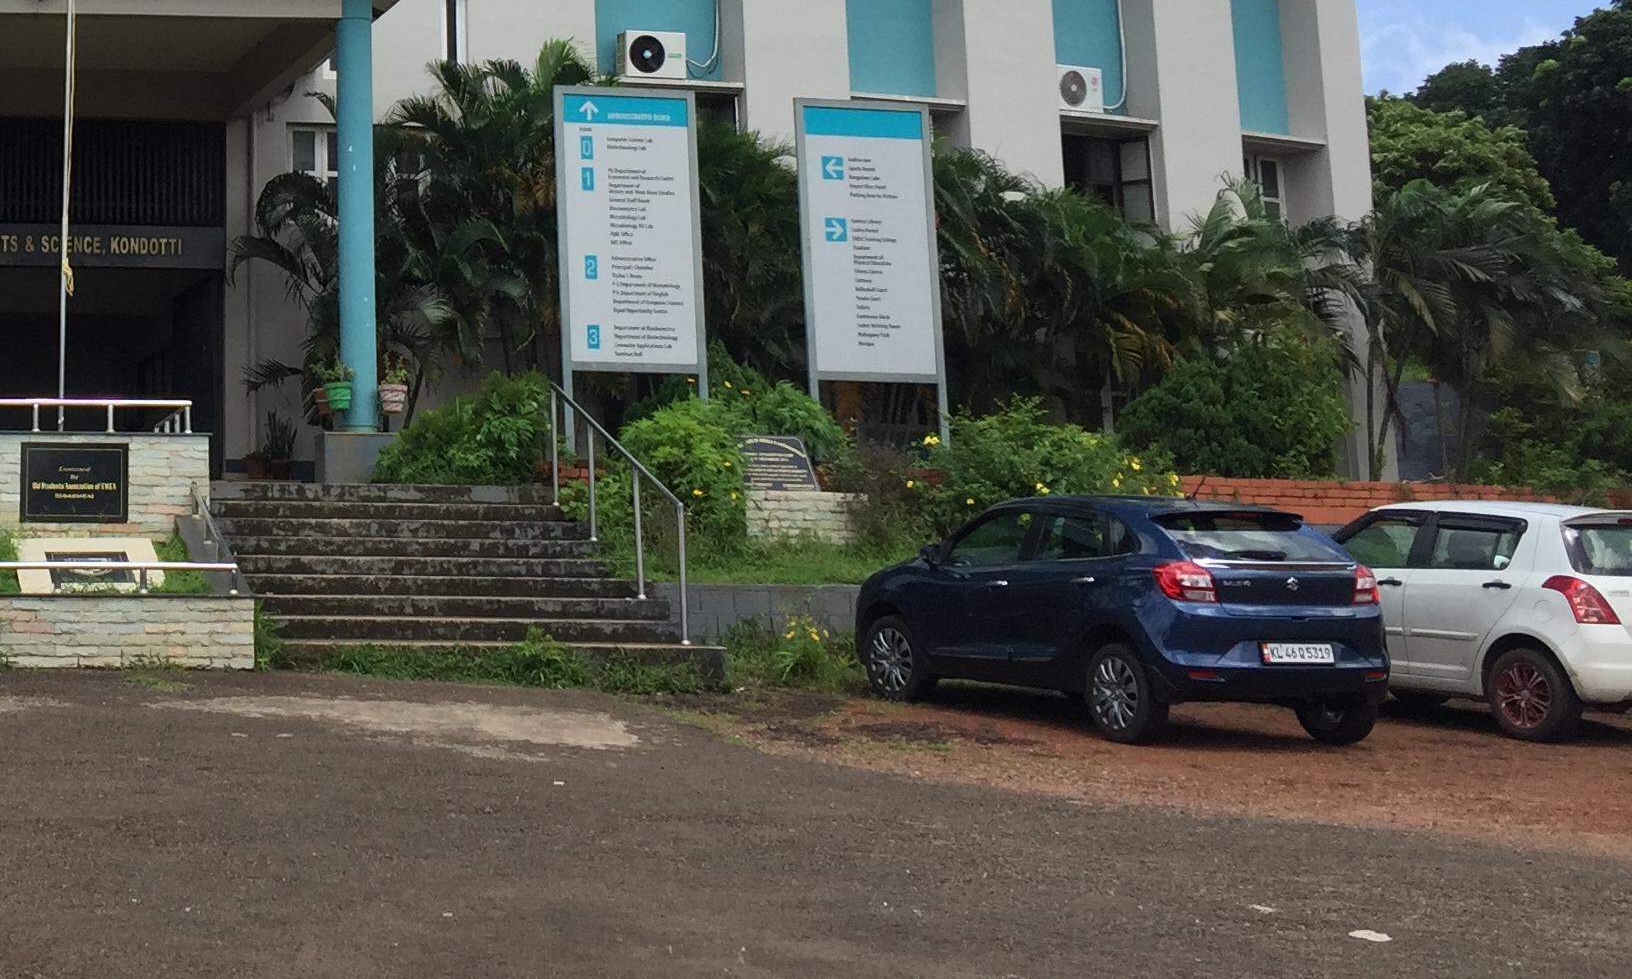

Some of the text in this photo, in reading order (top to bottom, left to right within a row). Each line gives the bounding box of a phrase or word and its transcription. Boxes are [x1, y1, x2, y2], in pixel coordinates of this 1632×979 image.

[25, 235, 35, 253] &
[41, 235, 106, 255] SCENCE,
[110, 236, 182, 255] KONDOTTI
